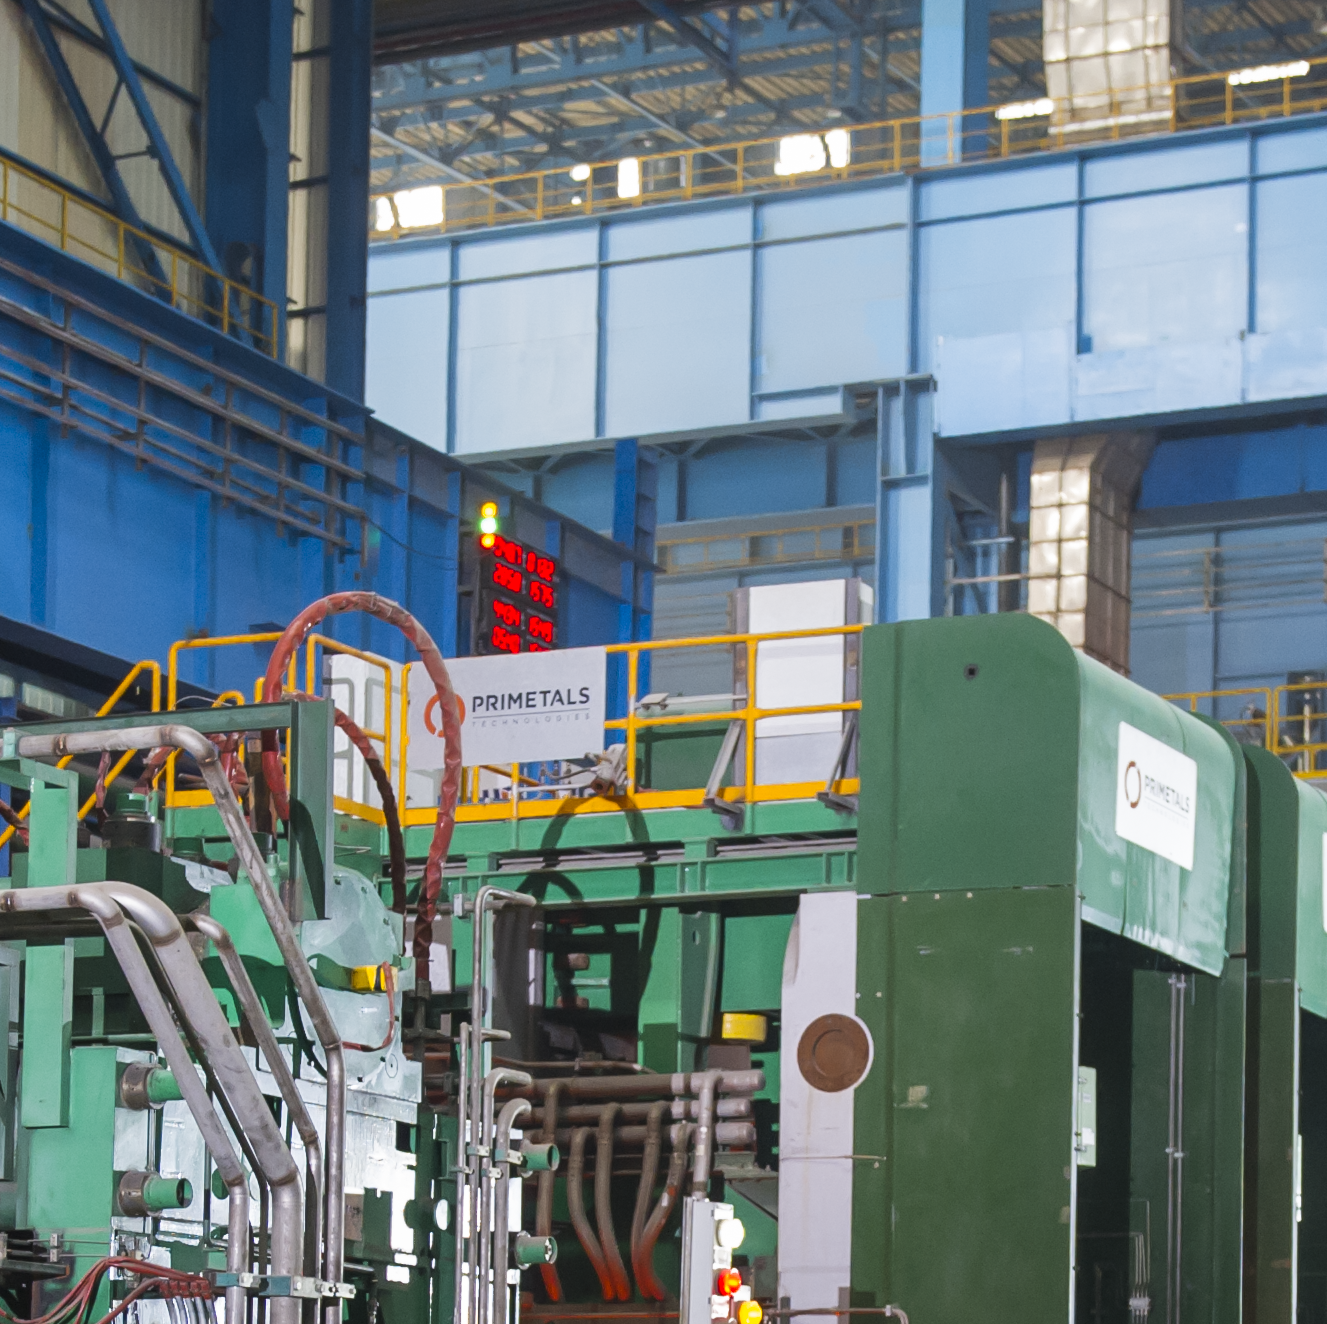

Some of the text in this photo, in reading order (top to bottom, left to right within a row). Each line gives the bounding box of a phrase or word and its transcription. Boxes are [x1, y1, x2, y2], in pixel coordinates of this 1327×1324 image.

[472, 687, 590, 713] PRIMETALS
[472, 712, 591, 728] TECHNOLOGIES
[1144, 774, 1191, 814] PRIMETALS
